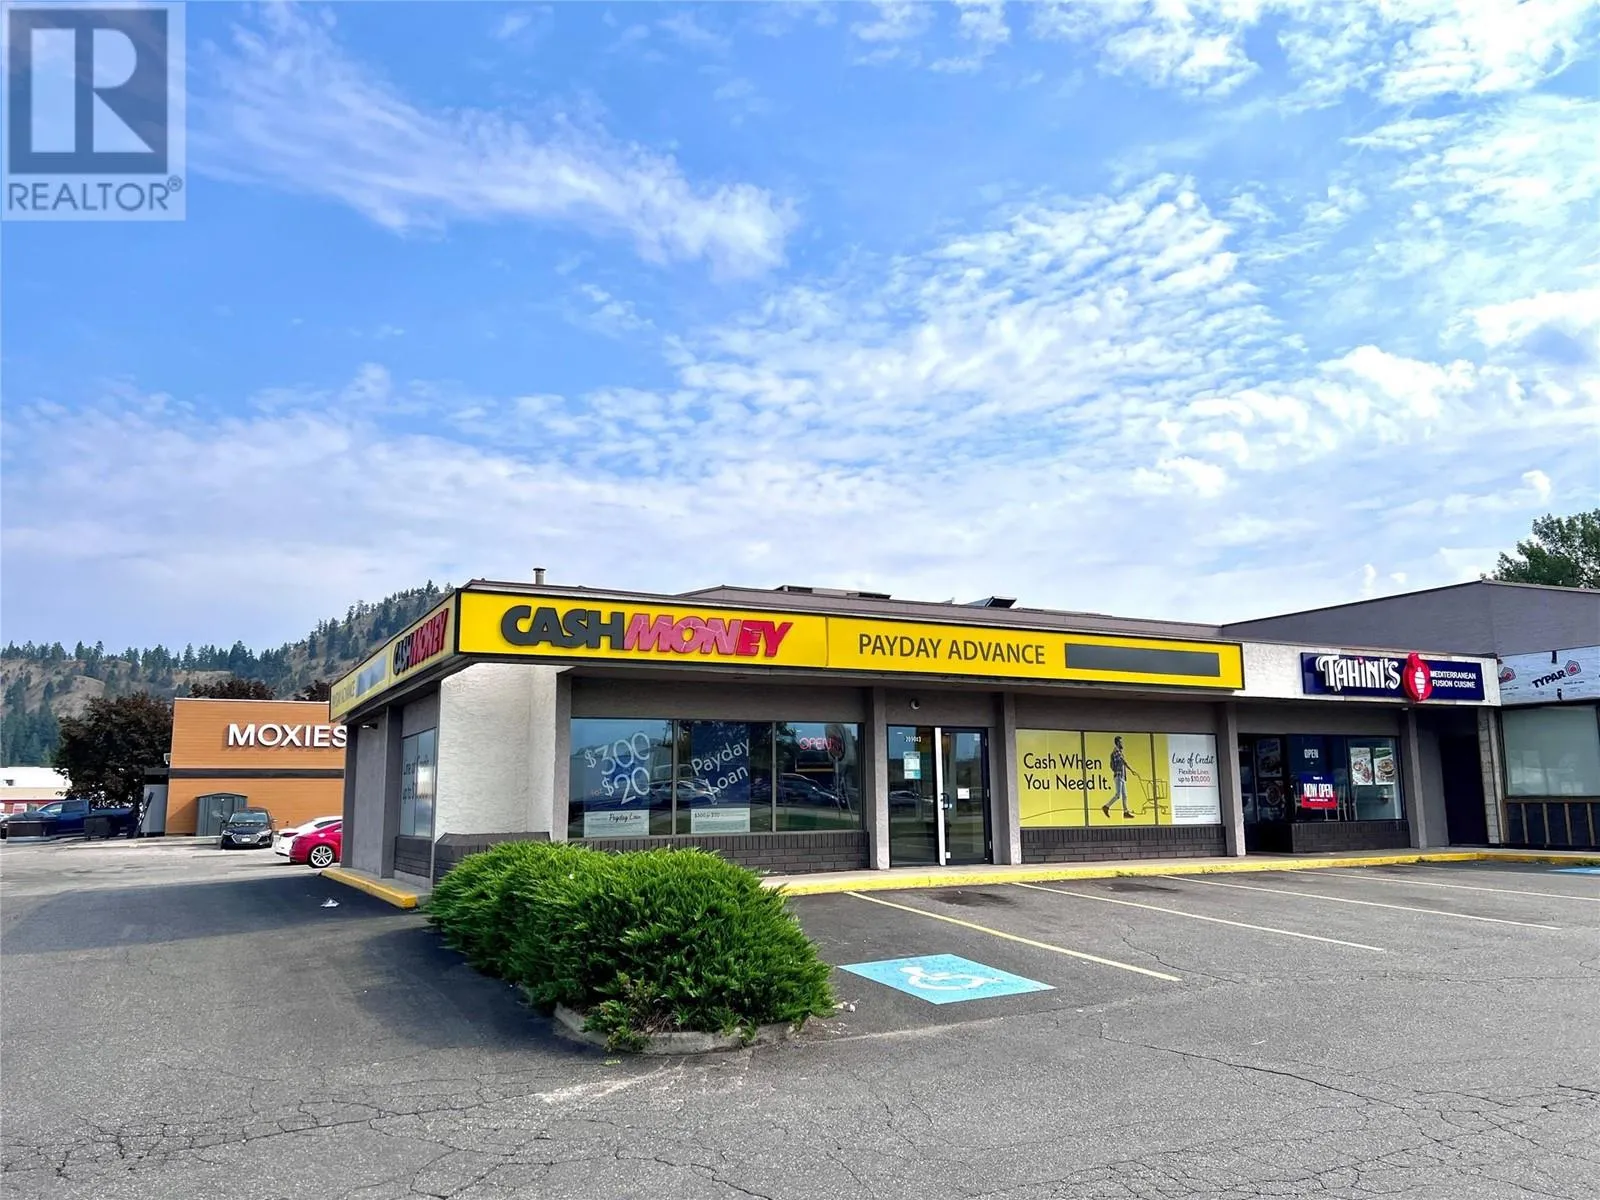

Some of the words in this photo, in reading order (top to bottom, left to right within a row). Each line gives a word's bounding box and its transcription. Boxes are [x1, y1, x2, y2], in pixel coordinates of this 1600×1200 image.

[858, 632, 942, 658] PAYDAY
[947, 639, 1046, 665] ADVANCE
[1429, 670, 1477, 680] MEDITERRANEAN
[1431, 679, 1453, 688] FUSION
[1453, 680, 1476, 689] CUISINE
[1531, 669, 1567, 688] TYPAR
[227, 723, 348, 748] MOXIES
[799, 737, 832, 750] OPEN
[584, 732, 650, 776] $300
[691, 738, 750, 776] Payday
[1023, 752, 1056, 769] Cash
[1059, 753, 1102, 770] When
[1171, 752, 1185, 764] Line
[1187, 752, 1195, 769] of
[1194, 753, 1215, 765] Credit
[1303, 748, 1319, 759] OPEN
[601, 766, 650, 806] $20
[705, 766, 749, 795] Loan
[1023, 773, 1050, 790] You
[1055, 774, 1095, 790] Need
[1098, 774, 1111, 790] It.
[1303, 783, 1318, 798] NOW
[1318, 783, 1334, 798] OPEN
